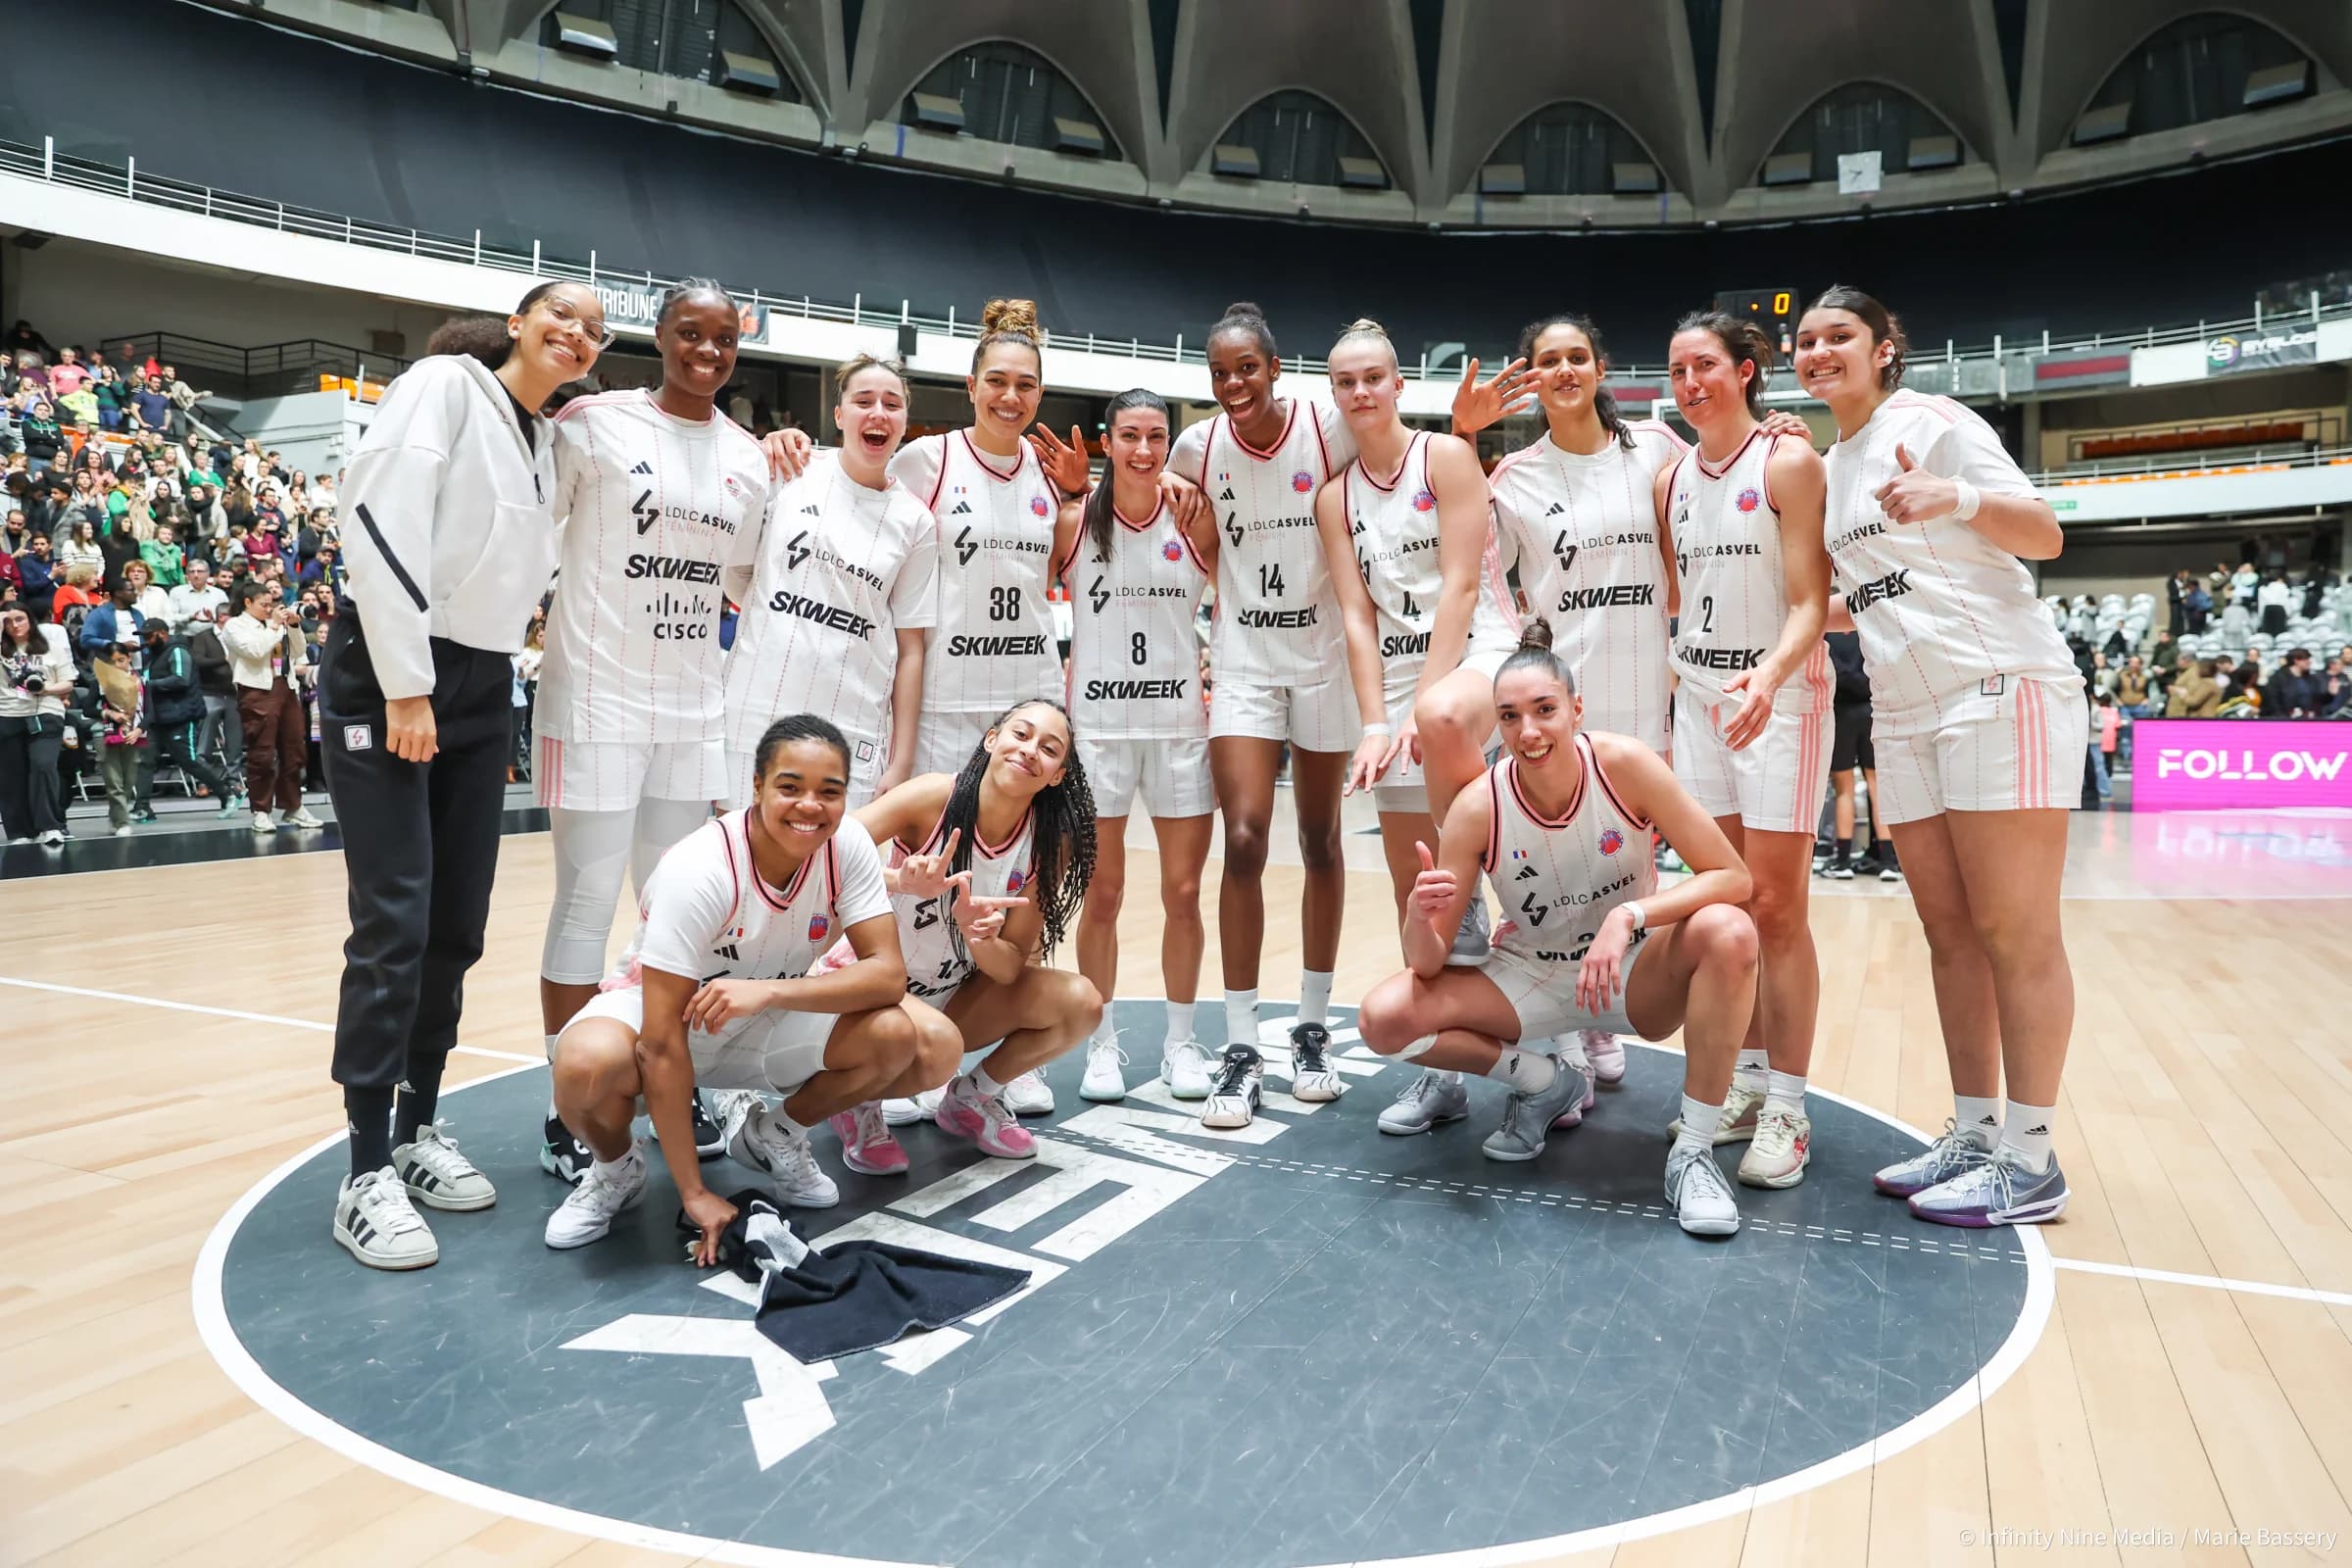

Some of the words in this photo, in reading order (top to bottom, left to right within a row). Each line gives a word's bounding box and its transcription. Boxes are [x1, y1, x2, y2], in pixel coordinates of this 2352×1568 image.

[595, 287, 659, 321] TRIBUNE
[1774, 293, 1790, 314] 0
[665, 505, 699, 521] LDLC
[701, 514, 736, 536] ASVEL
[1277, 516, 1316, 529] ASVEL
[983, 538, 1014, 551] LDLC
[1015, 540, 1050, 556] ASVEL
[1583, 535, 1615, 550] LDLC
[1617, 532, 1654, 545] ASVEL
[1715, 543, 1762, 557] ASVEL
[815, 548, 845, 568] LDLC
[846, 564, 884, 592] ASVEL
[1259, 564, 1286, 598] 14
[989, 586, 1021, 622] 38
[1116, 587, 1147, 597] LDLC
[1149, 587, 1188, 598] ASVEL
[1558, 583, 1655, 612] SKWEEK
[1845, 567, 1913, 614] KWEEK
[769, 590, 876, 641] SKWEEK
[1701, 596, 1714, 633] 2
[654, 622, 708, 640] CISCO
[948, 634, 1048, 658] SKWEEK
[1131, 631, 1148, 666] 8
[1084, 678, 1189, 701] SKWEEK
[2158, 749, 2348, 781] FOLLOW
[1552, 893, 1589, 907] LDLC
[1592, 872, 1637, 902] ASVEL
